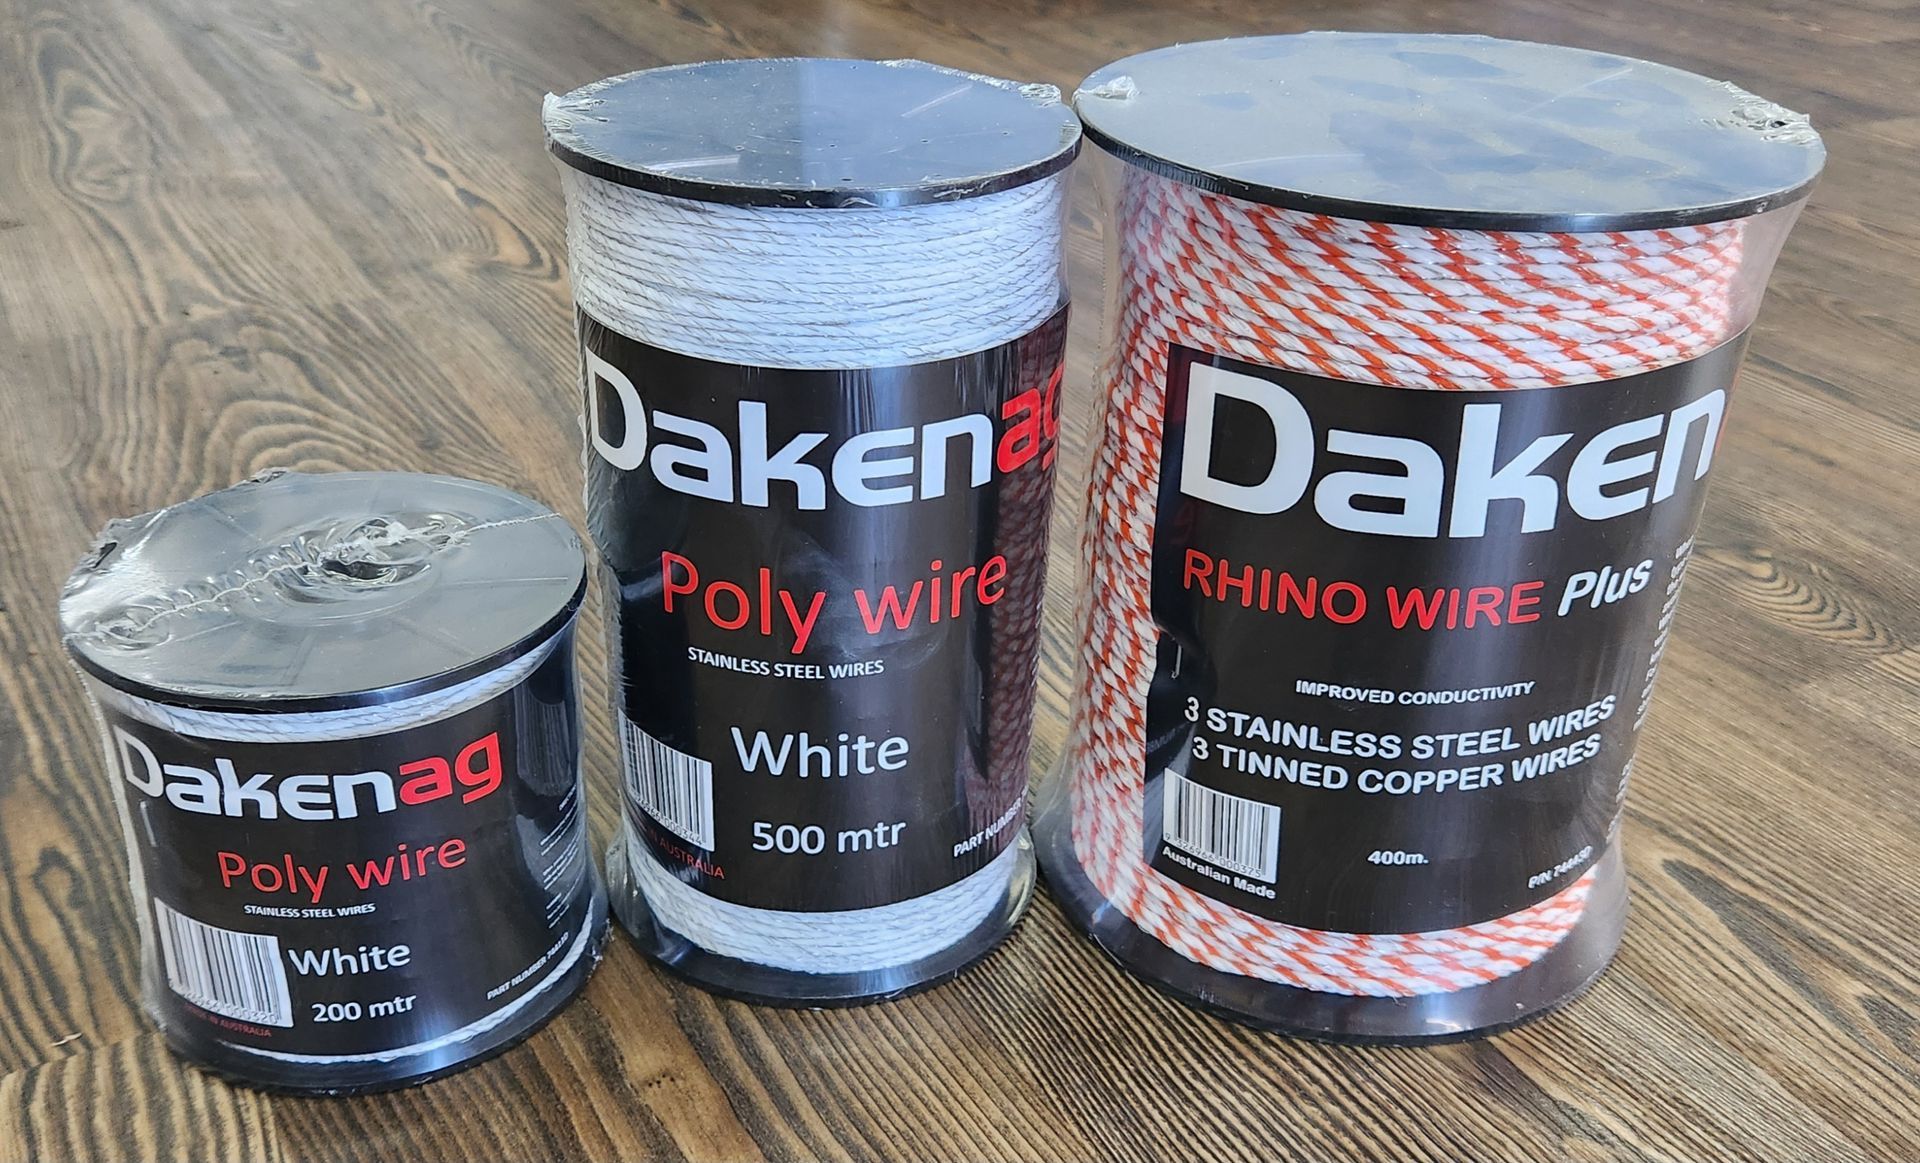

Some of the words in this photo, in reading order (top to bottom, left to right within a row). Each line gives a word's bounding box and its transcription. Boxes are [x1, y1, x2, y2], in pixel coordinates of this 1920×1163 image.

[1180, 360, 1730, 538] Daken
[661, 551, 826, 654] Poly
[854, 554, 1008, 635] wire
[1182, 548, 1368, 624] RHINO
[1386, 580, 1544, 630] WIRE
[1557, 558, 1654, 617] Plus
[688, 646, 770, 677] STAINLESS
[774, 663, 825, 680] STEEL
[829, 659, 886, 679] WIRES
[1295, 680, 1395, 705] IMPROVED
[1398, 680, 1536, 706] CONDUCTIVITY
[1184, 696, 1200, 723] 3
[1206, 707, 1402, 760] STAINLESS
[1410, 726, 1520, 761] STEEL
[1528, 695, 1616, 746] WIRES
[114, 724, 503, 821] Dakenag
[730, 726, 910, 778] White
[1192, 736, 1209, 762] 3
[1216, 743, 1349, 791] TINNED
[1357, 763, 1504, 795] COPPER
[1511, 733, 1602, 783] WIRES
[752, 821, 825, 854] 500
[837, 821, 907, 853] mtr
[953, 831, 985, 857] PART
[1367, 850, 1430, 866] 400m.
[217, 850, 326, 904] Poly
[347, 837, 467, 891] wire
[660, 838, 725, 879] AUSTRALIA
[1162, 846, 1231, 885] Australian
[1233, 877, 1277, 899] Made
[244, 903, 301, 919] STAINLESS
[302, 907, 336, 918] STEEL
[337, 903, 376, 917] WIRES
[288, 942, 411, 977] White
[312, 1002, 362, 1024] 200
[369, 991, 417, 1017] mtr
[487, 981, 511, 1000] PART
